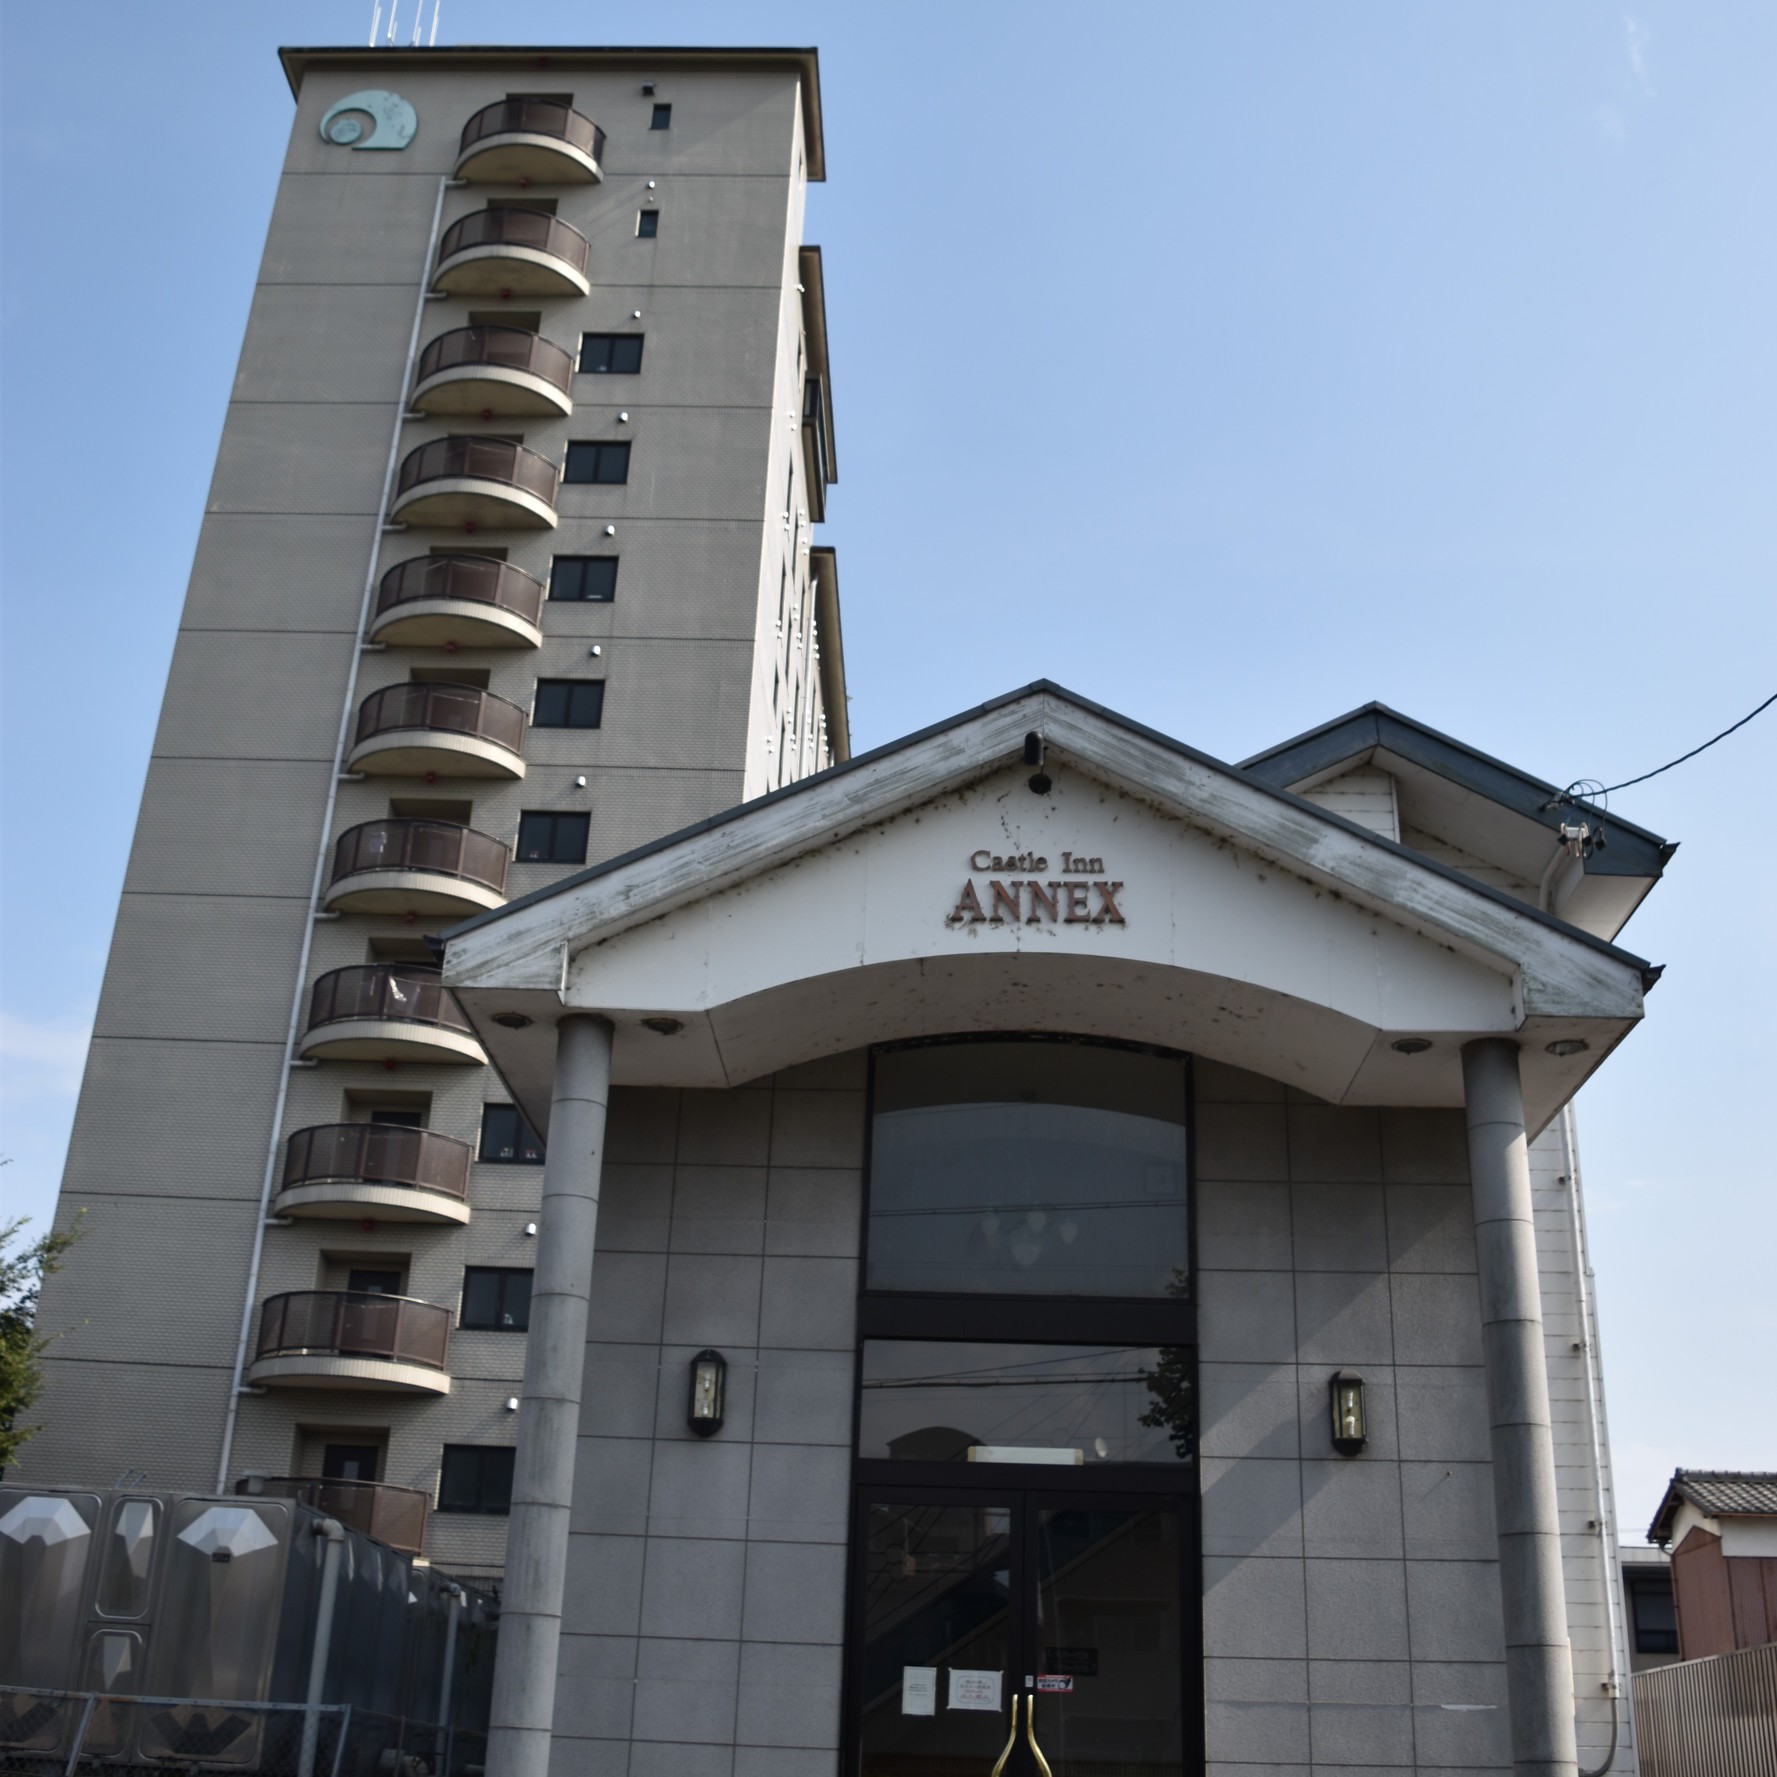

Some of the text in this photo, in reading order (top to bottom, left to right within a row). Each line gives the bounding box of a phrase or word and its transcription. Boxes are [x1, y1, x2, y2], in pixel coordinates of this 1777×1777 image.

[970, 850, 1104, 873] Castle Inn
[950, 878, 1125, 923] ANNEX
